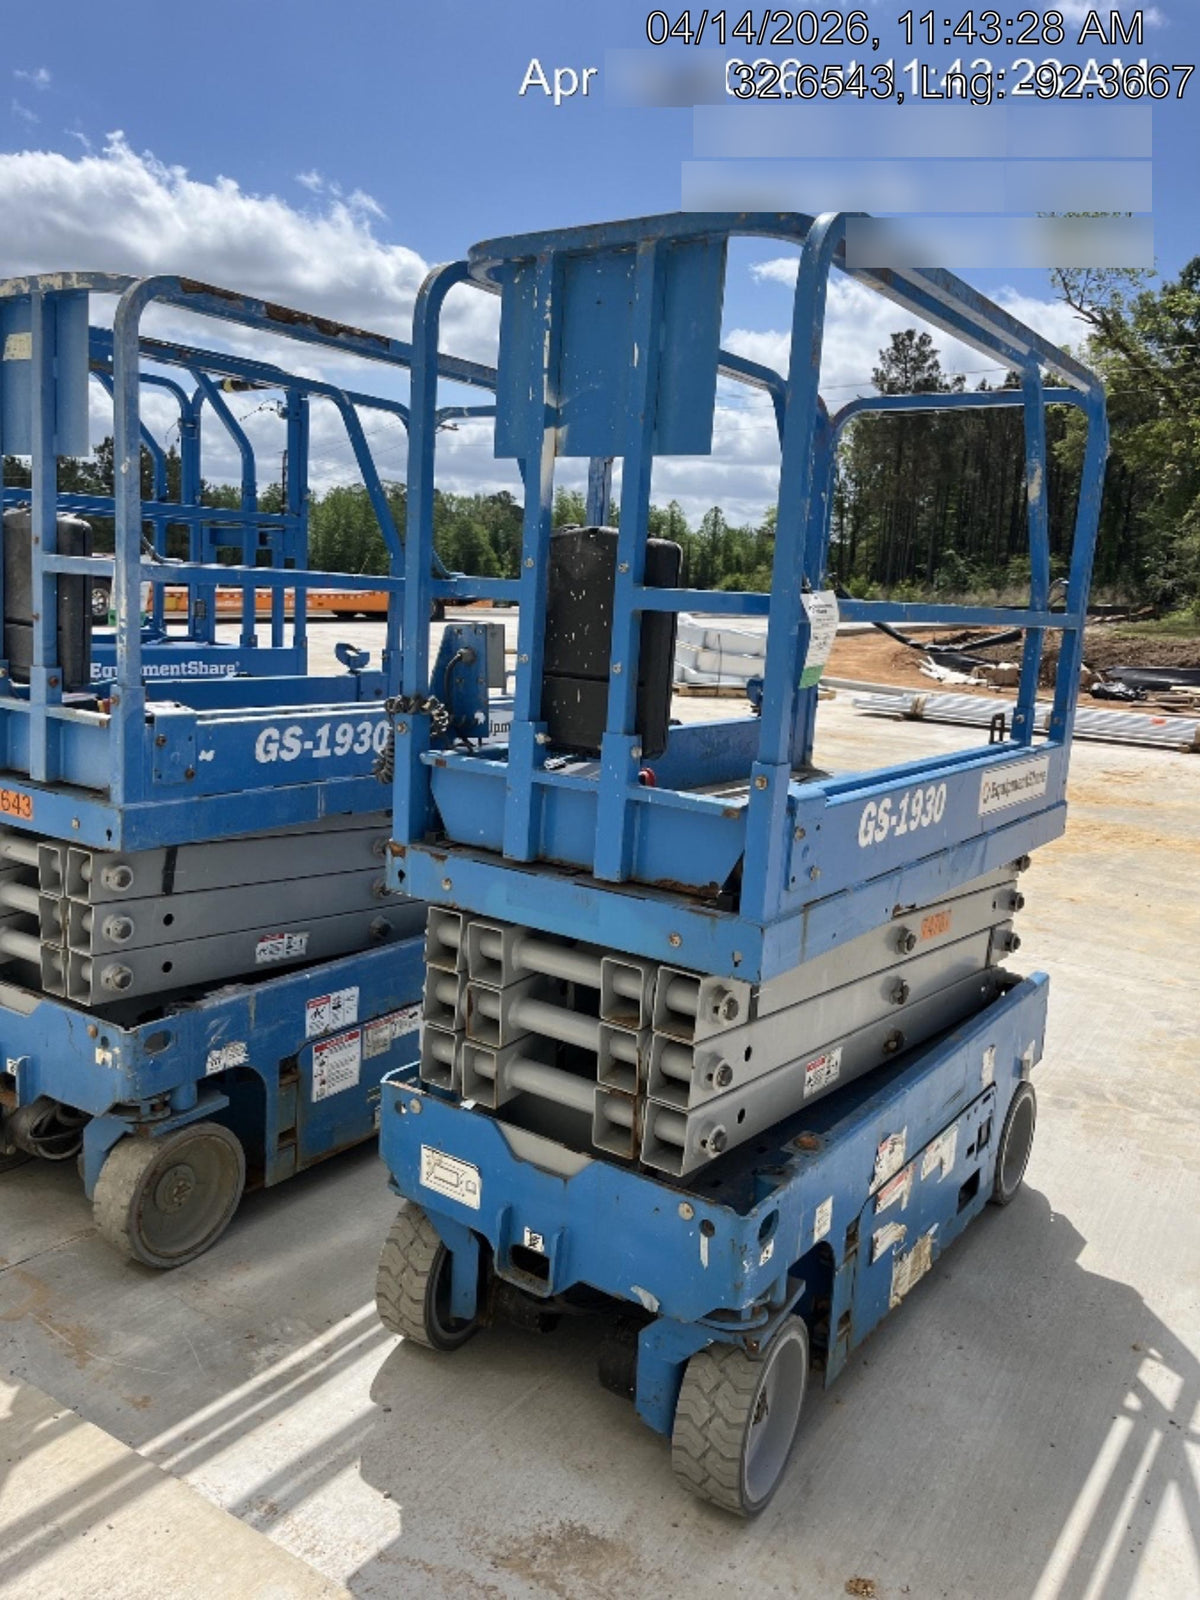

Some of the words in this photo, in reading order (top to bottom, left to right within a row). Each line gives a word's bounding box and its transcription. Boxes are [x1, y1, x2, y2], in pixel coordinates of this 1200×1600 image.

[90, 661, 236, 680] EqmentShare
[255, 719, 392, 764] GS-1930
[858, 782, 947, 849] GS-1930
